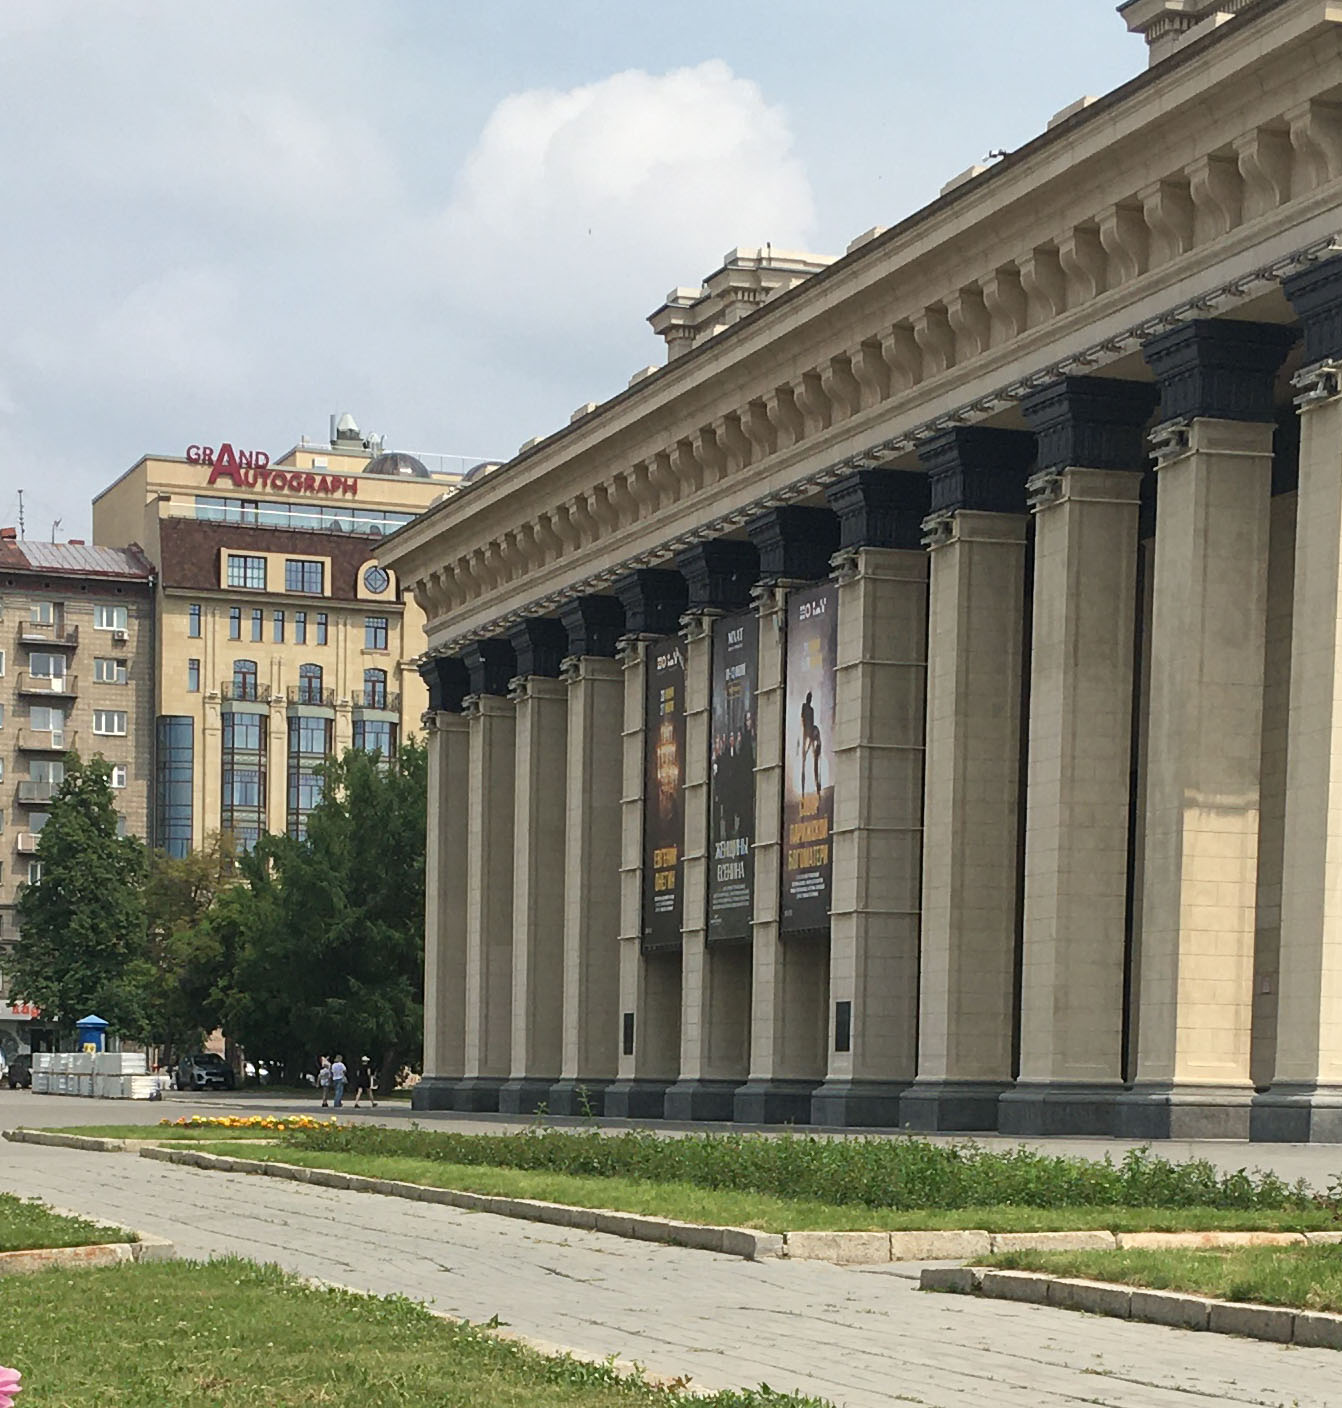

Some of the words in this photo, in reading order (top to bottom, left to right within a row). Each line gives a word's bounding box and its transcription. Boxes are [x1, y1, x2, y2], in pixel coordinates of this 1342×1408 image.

[186, 443, 269, 487] GRAND
[207, 443, 358, 498] AUTOGRAPH
[715, 837, 748, 860] ЖЕНЩИНЫ
